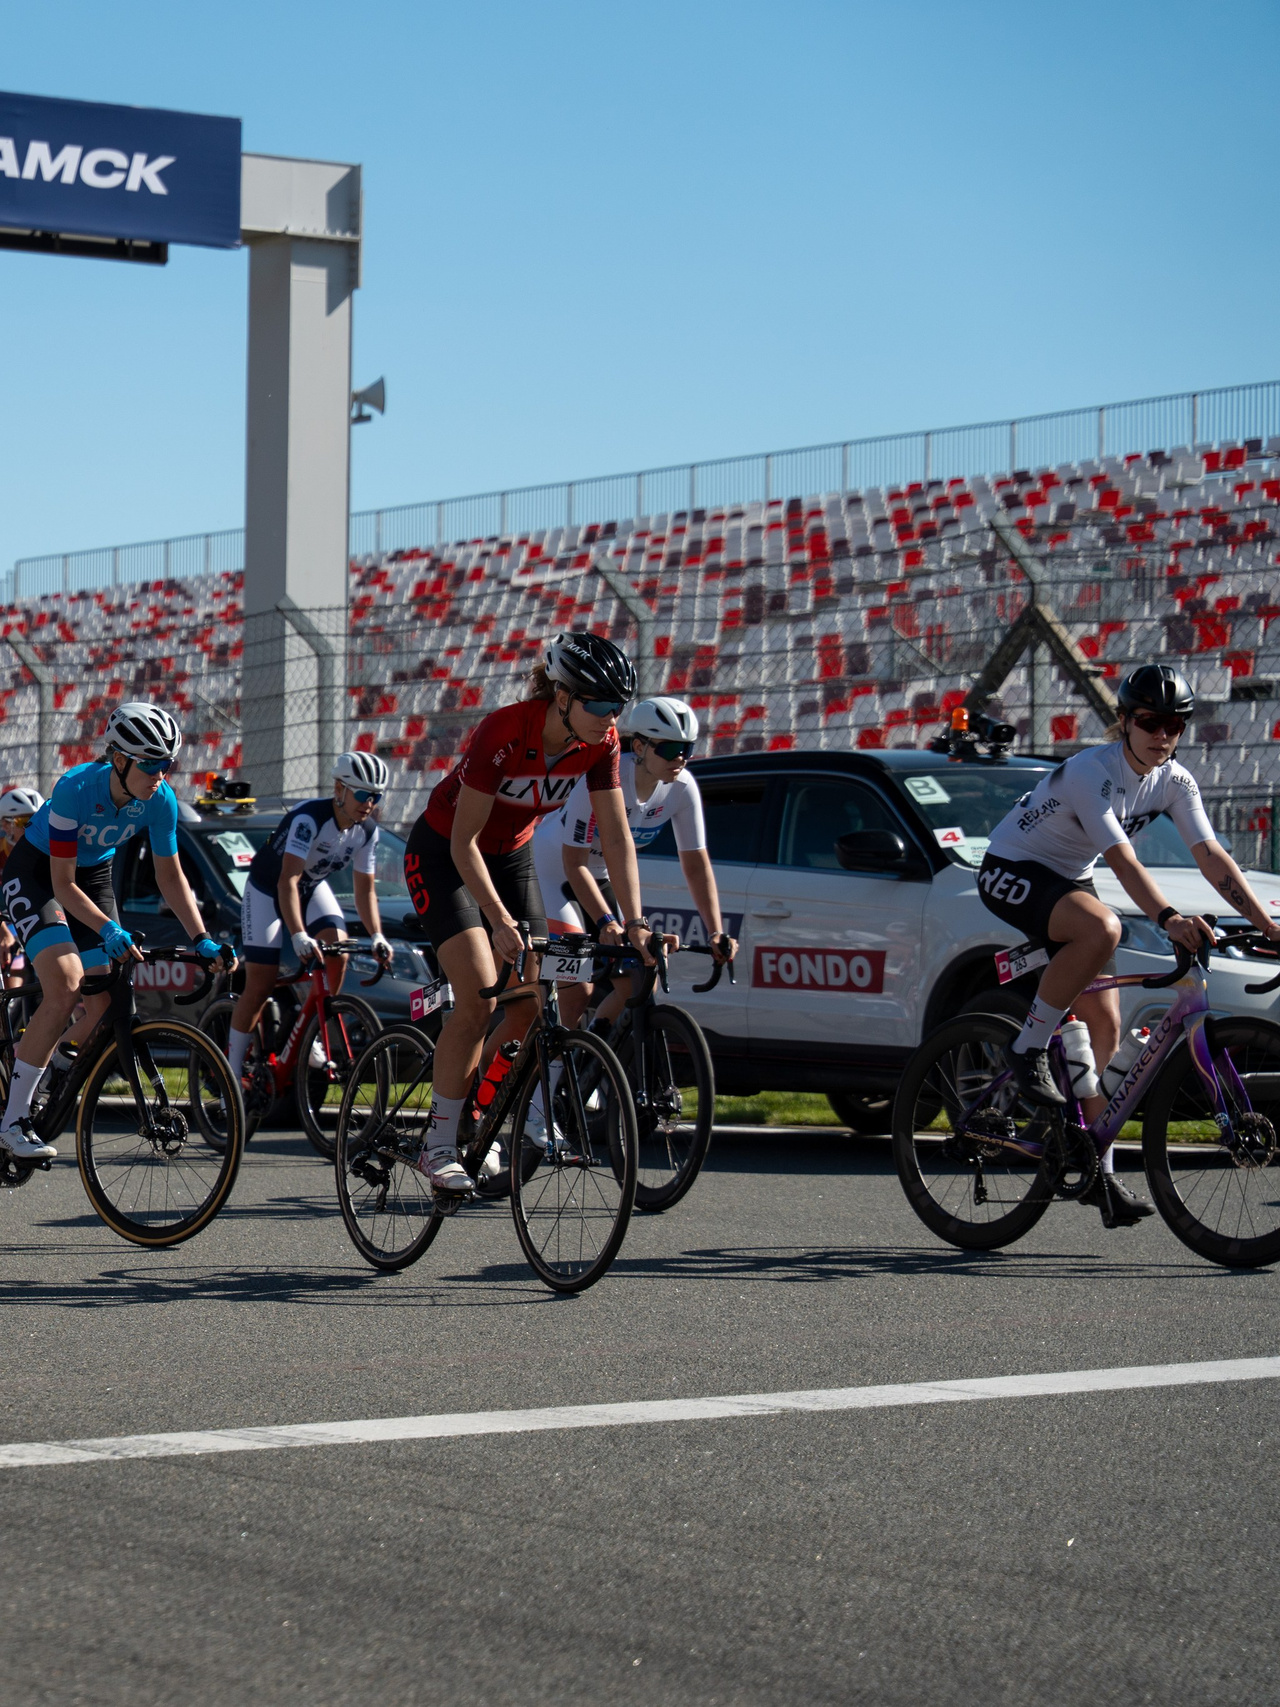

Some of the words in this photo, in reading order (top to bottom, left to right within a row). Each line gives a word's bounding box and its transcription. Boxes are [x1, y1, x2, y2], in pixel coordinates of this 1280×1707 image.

[917, 780, 937, 797] B
[78, 823, 137, 847] RCA
[941, 832, 961, 842] 4
[404, 853, 431, 915] RED
[980, 866, 1031, 905] RED
[2, 877, 40, 943] RCA
[137, 961, 187, 986] NDO
[556, 958, 581, 974] 241
[761, 954, 873, 988] FONDO
[999, 961, 1009, 974] D
[413, 998, 423, 1011] D
[1101, 1016, 1172, 1128] PINARELLO
